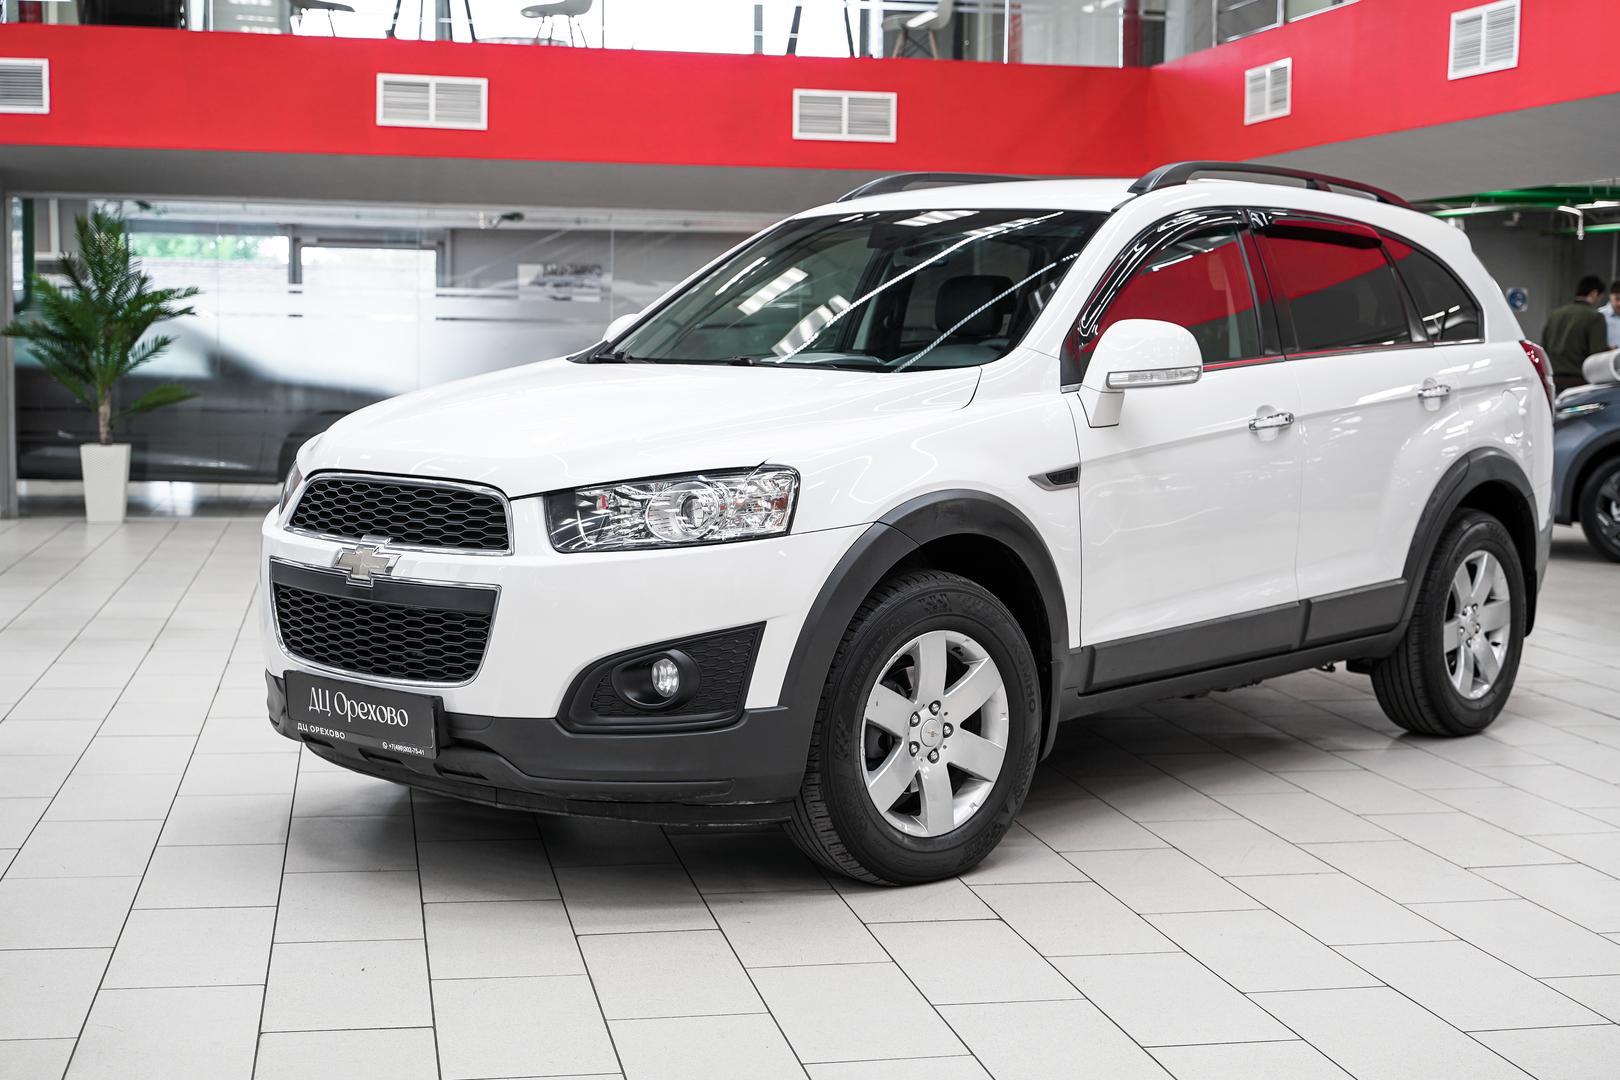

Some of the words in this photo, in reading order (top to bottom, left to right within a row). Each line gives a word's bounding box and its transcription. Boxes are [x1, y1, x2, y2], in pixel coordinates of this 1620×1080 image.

[308, 686, 332, 717] ДЦ
[333, 691, 409, 727] Орехово
[297, 722, 309, 733] ДЦ
[309, 724, 346, 740] ОРЕХОВО
